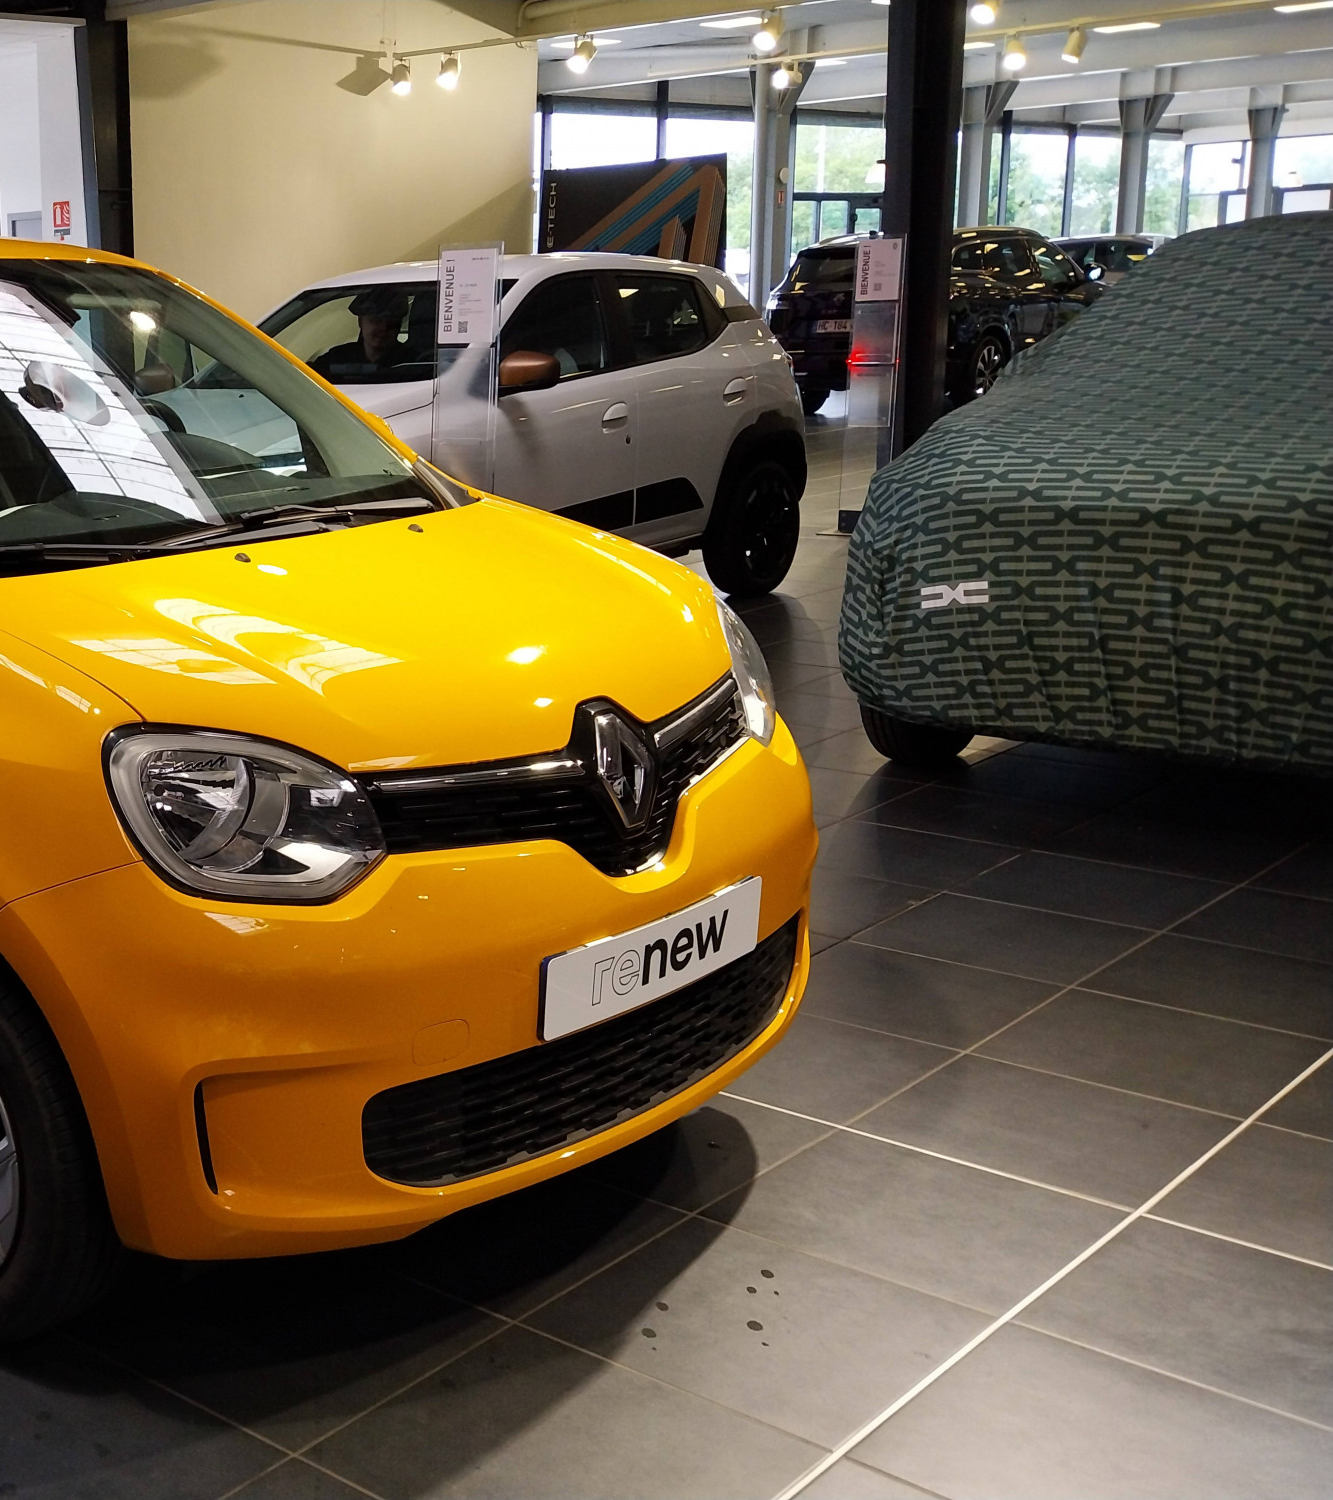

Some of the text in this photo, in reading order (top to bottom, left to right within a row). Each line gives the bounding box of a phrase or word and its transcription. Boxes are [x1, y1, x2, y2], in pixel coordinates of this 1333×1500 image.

[546, 182, 557, 248] E-TECH
[443, 265, 455, 333] BIENVENUE
[860, 249, 871, 296] BIENVENUE
[591, 908, 730, 1007] renew
